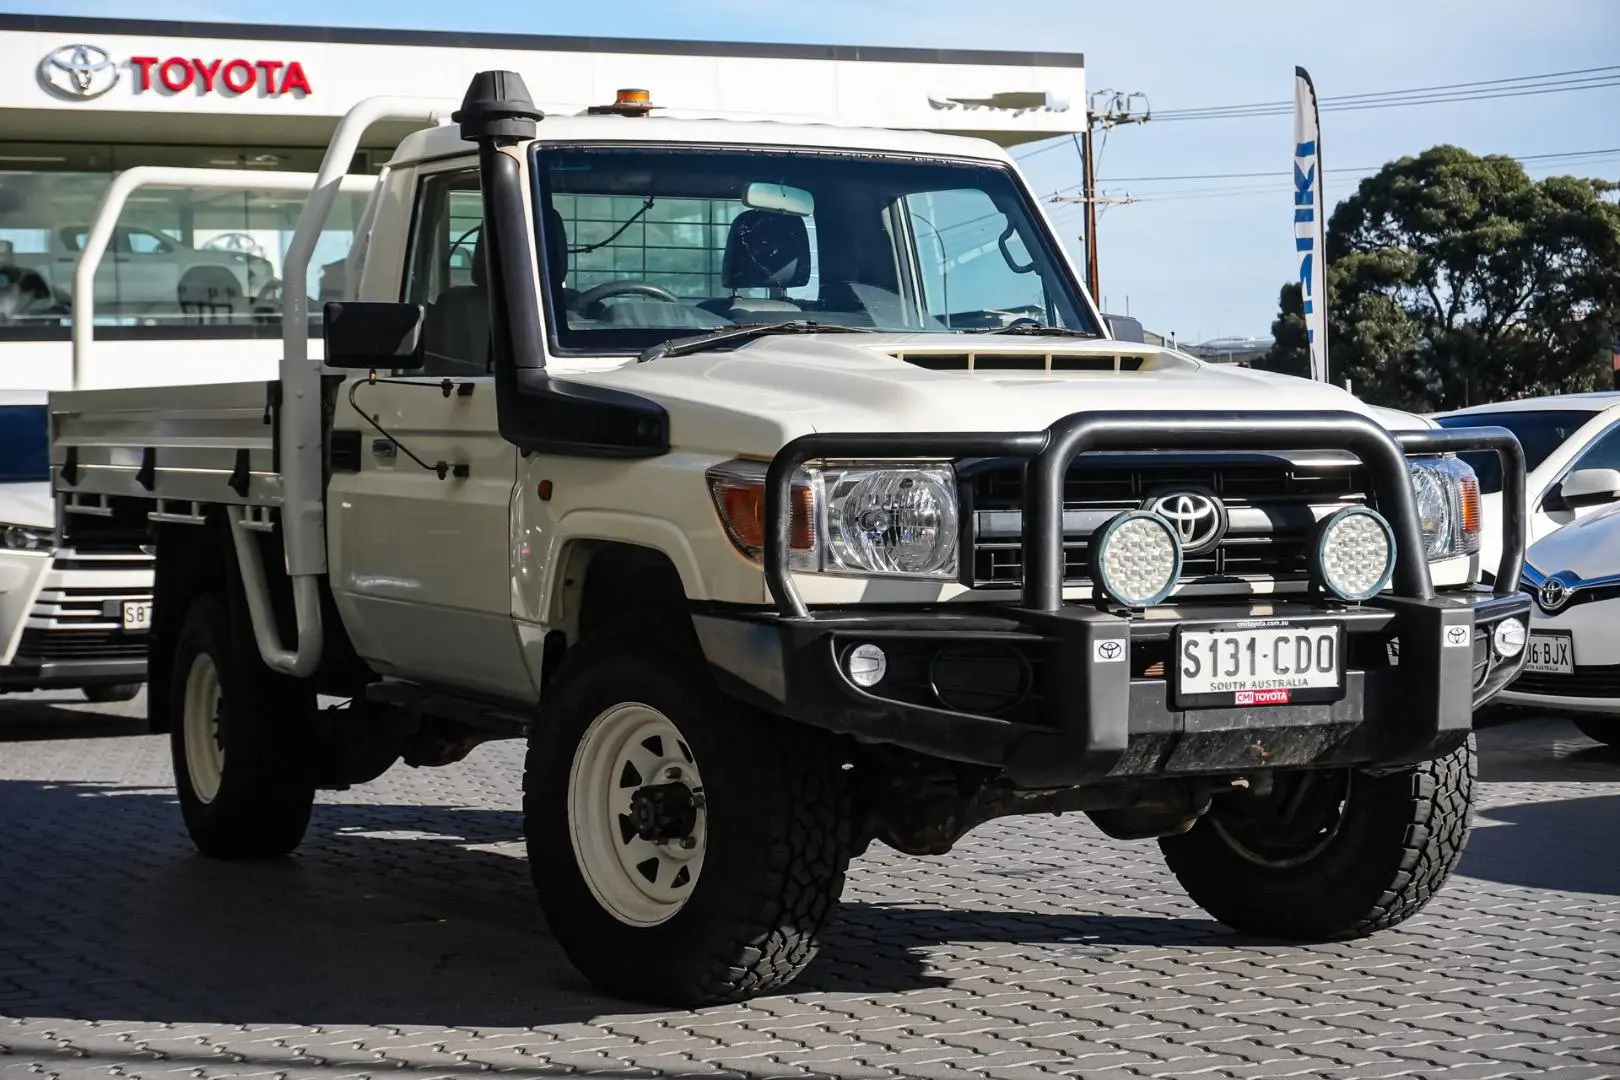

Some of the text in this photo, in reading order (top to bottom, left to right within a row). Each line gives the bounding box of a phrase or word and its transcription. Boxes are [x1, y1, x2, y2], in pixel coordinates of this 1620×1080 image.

[131, 56, 312, 95] TOYOTA
[1210, 678, 1308, 691] SOUTH AUSTRALIA
[1236, 691, 1288, 702] CMI TOYOTA
